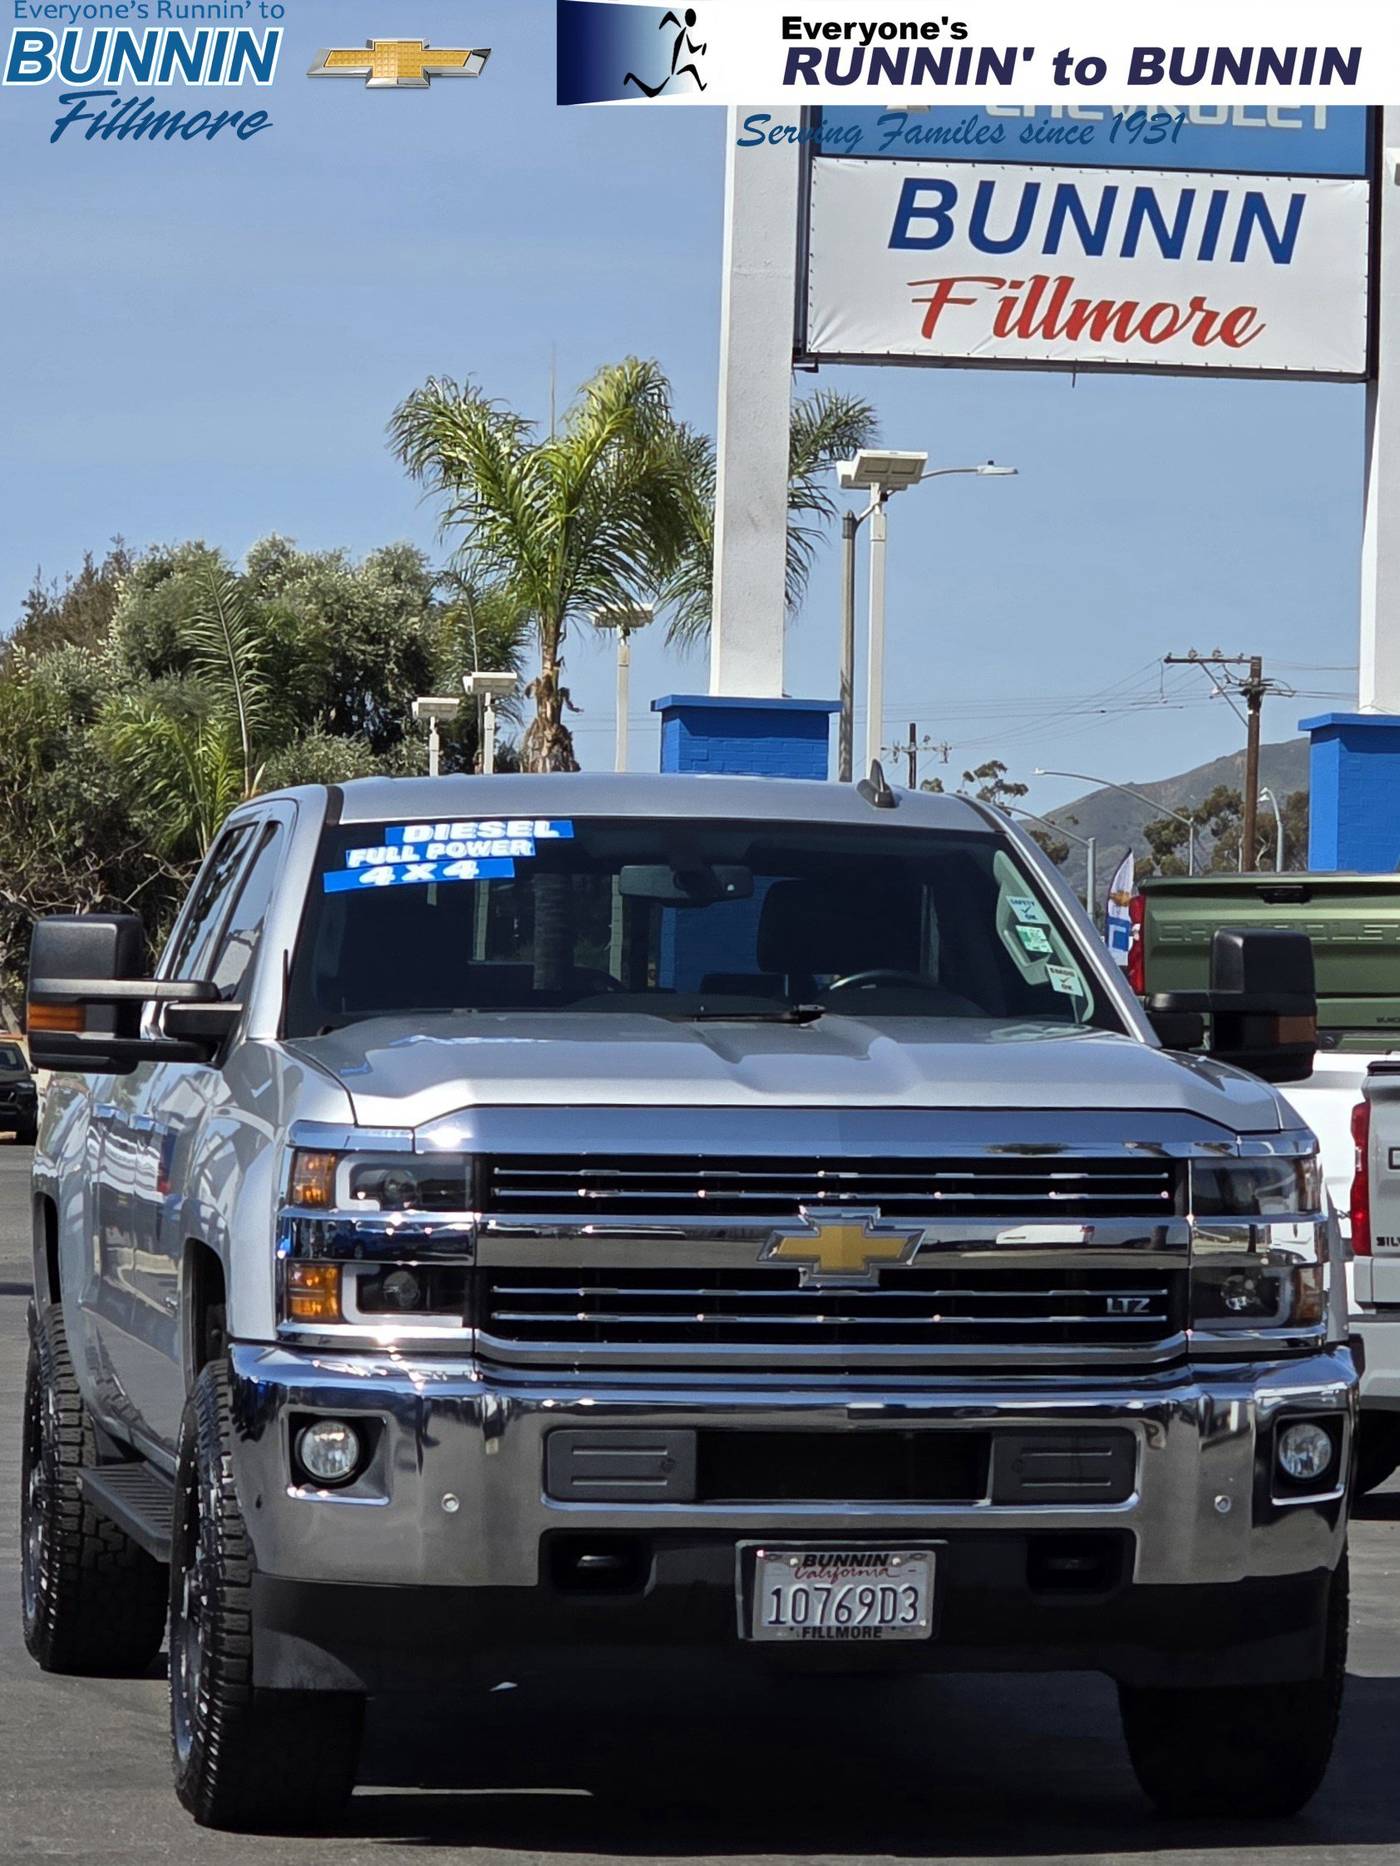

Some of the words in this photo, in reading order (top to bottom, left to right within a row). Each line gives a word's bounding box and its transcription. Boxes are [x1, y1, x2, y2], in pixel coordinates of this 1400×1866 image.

[888, 177, 1306, 264] BUNNIN
[906, 274, 1266, 349] Fillmore
[402, 820, 560, 843] DIESEL
[348, 845, 421, 868] FULL
[426, 839, 534, 859] POWER
[359, 866, 397, 886] 4
[443, 859, 479, 879] 4
[1376, 1236, 1400, 1247] SIL
[1106, 1297, 1150, 1313] LTZ
[802, 1554, 890, 1567] BUNNIN
[767, 1585, 919, 1625] 10769D3
[801, 1626, 882, 1639] FILLMORE
